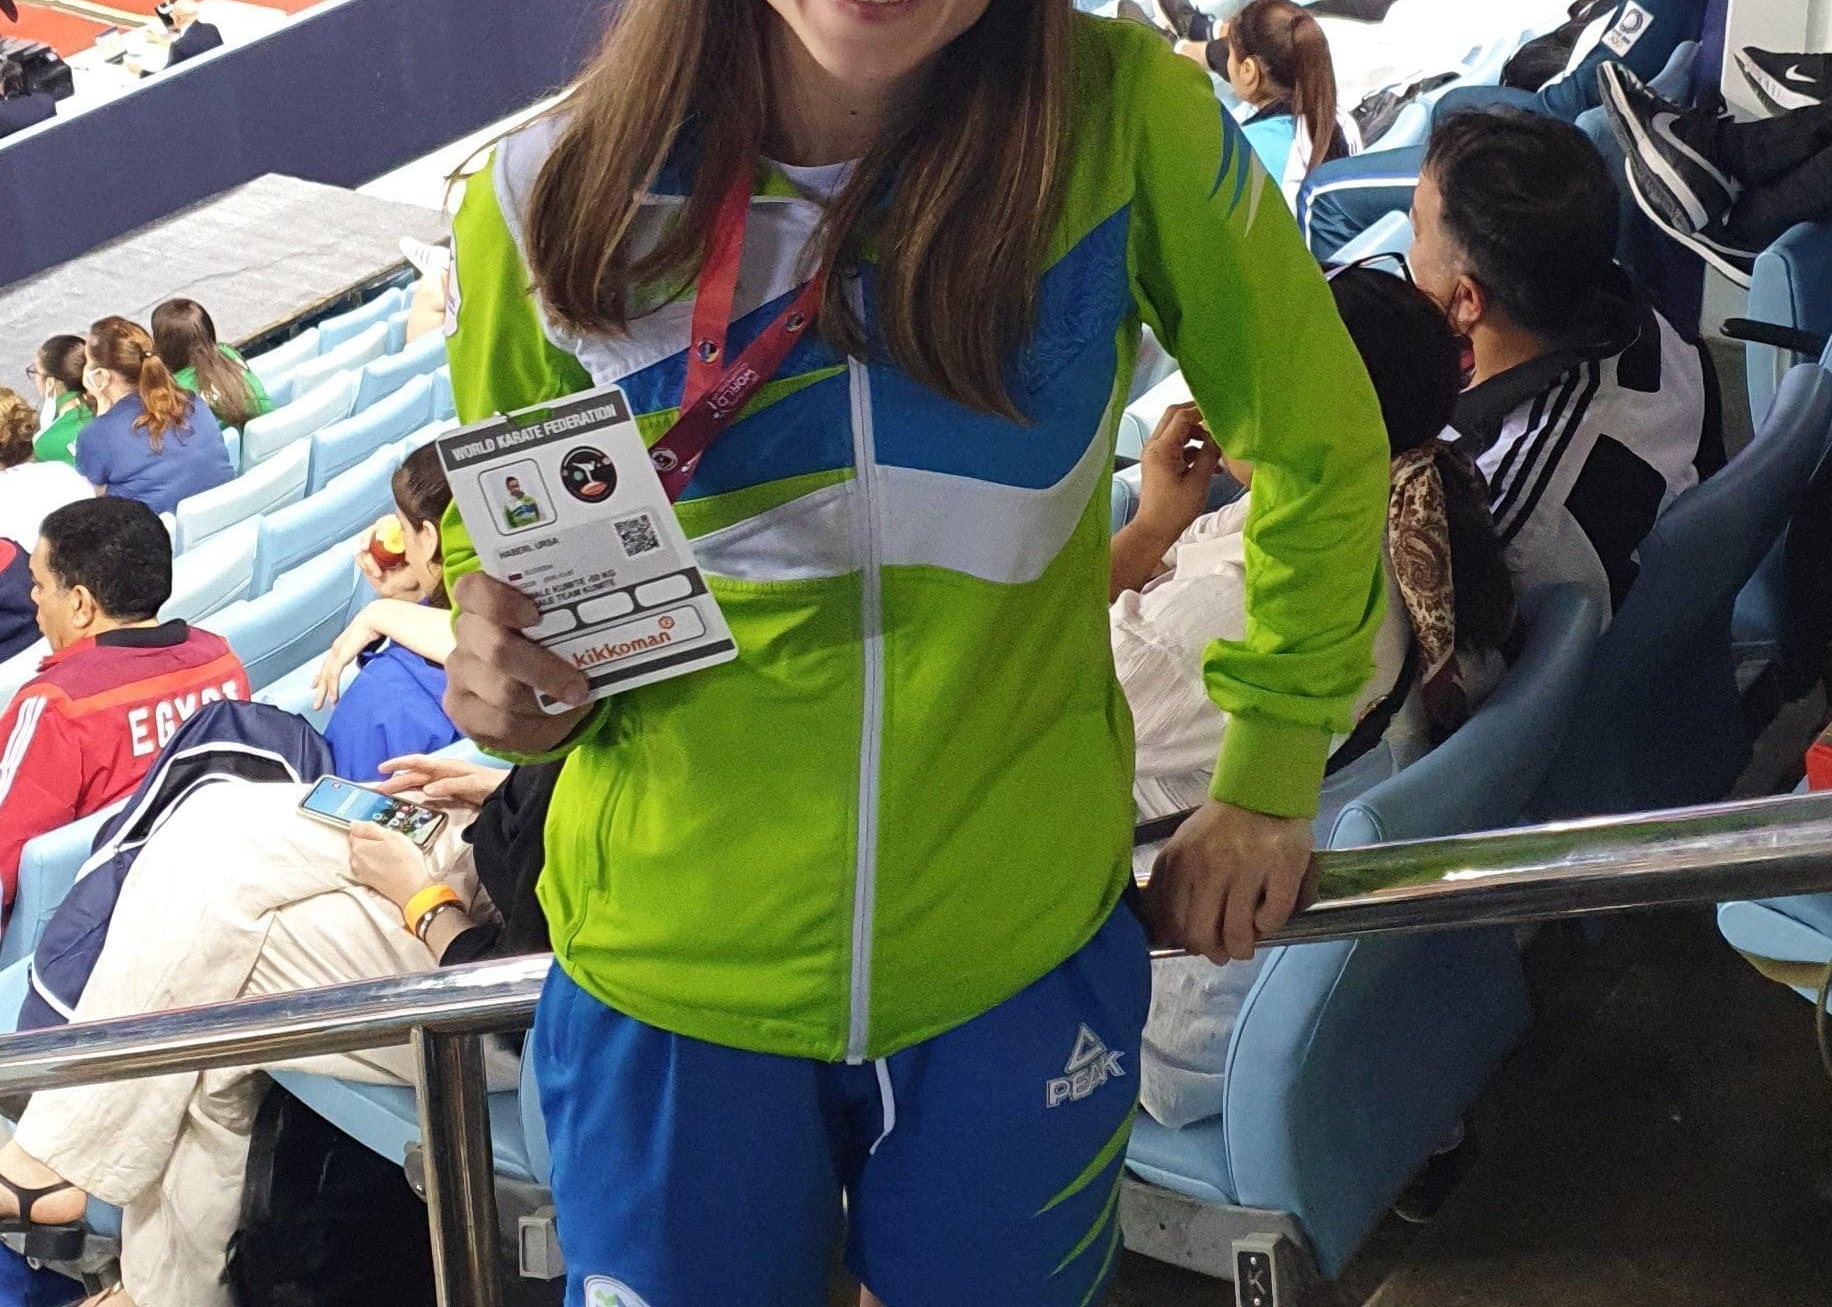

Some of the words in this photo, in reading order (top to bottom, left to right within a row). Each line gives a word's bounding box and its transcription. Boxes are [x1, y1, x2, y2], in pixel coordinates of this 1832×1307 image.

[451, 436, 496, 462] WORLD
[495, 425, 545, 449] KARATE
[543, 403, 617, 436] FEDERATION
[572, 632, 672, 668] kikkoman
[1046, 1050, 1127, 1108] PEAK
